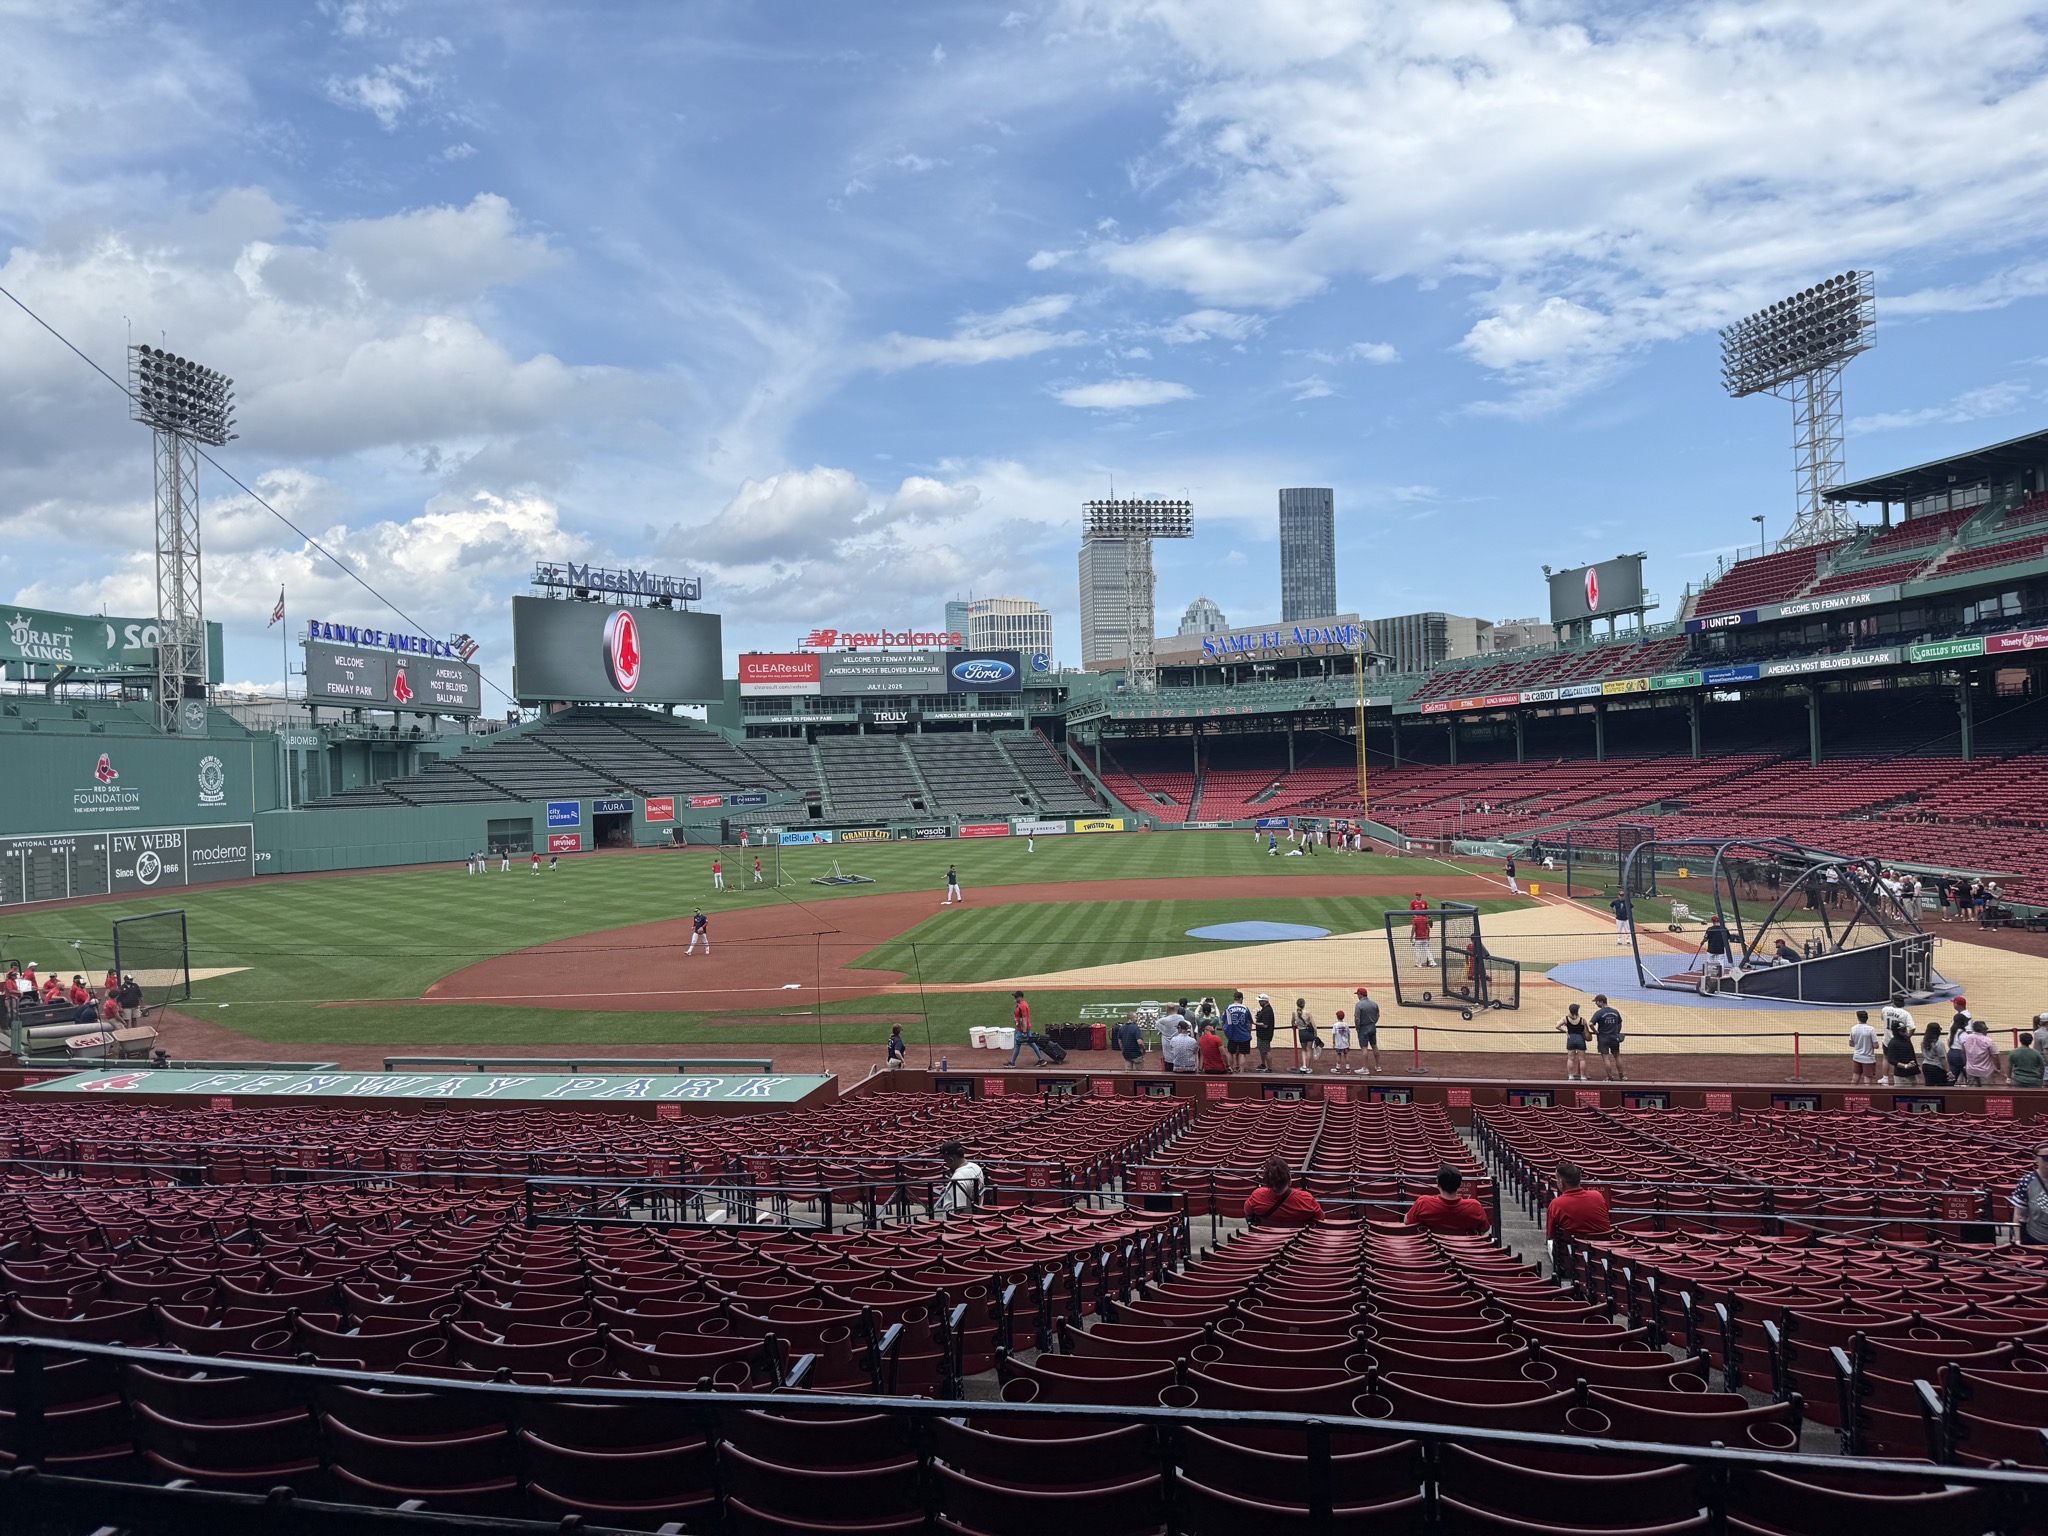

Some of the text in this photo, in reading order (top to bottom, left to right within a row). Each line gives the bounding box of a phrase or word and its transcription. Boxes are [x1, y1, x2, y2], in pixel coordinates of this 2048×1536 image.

[567, 561, 702, 600] MassMutual
[1780, 594, 1871, 616] WELCOME TO FENWAY PARK
[1710, 615, 1741, 627] UNITED
[11, 628, 73, 647] DRAFT
[310, 620, 454, 657] BANK OF AMERICA
[842, 628, 962, 646] new balance
[1202, 622, 1367, 658] SAMUEL ADAMS
[2001, 637, 2022, 647] Ninety
[20, 644, 73, 660] KINGS
[1921, 643, 1980, 657] GRILLO'S PICKLES
[335, 655, 364, 668] WELCOME
[1768, 653, 1889, 675] AMERICA'S MOST BELOVED BALLPARK
[748, 663, 812, 673] CLEAResult
[965, 663, 1001, 679] Ford
[346, 671, 354, 681] TO
[436, 669, 462, 680] AMERICA'S
[327, 683, 373, 696] FENWAY PARK
[430, 681, 469, 692] MOST BELOVED
[436, 694, 464, 704] BALLPARK
[873, 712, 908, 721] TRULY
[74, 794, 138, 804] FOUNDATION
[842, 831, 873, 840] GRANITE
[874, 830, 890, 839] CITY
[917, 827, 945, 835] wasabi
[13, 840, 47, 848] NATIONAL
[113, 833, 182, 853] F.W. WEBB
[781, 834, 809, 844] jetBlue
[192, 845, 247, 861] moderna
[254, 853, 272, 861] 379
[115, 864, 179, 878] Since 1866
[1232, 1014, 1245, 1025] 54
[175, 1074, 792, 1099] FENWAY PARK
[1030, 1179, 1046, 1187] 59
[1141, 1182, 1156, 1190] 58
[1948, 1210, 1968, 1219] 55
